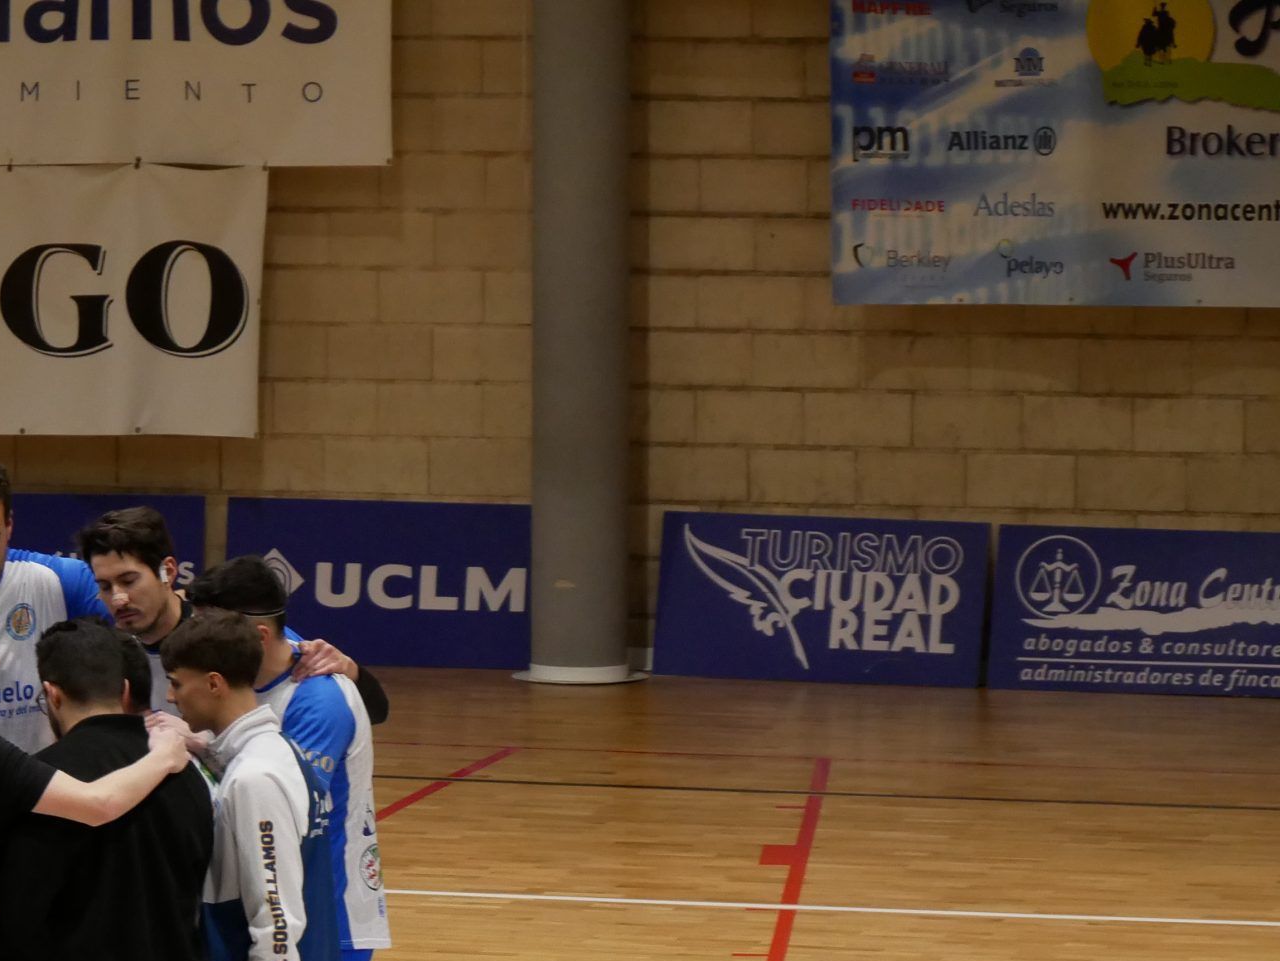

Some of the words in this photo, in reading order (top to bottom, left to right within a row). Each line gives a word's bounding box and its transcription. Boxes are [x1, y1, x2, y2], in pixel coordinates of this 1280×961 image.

[947, 131, 1029, 151] Allianz
[973, 193, 1055, 217] Adeslas
[1007, 256, 1064, 278] pelayo
[1144, 252, 1236, 271] PlusUltra
[741, 528, 964, 577] TURISMO
[315, 562, 527, 613] UCLM
[780, 567, 962, 616] CIUDAD
[1106, 564, 1188, 610] Zona
[828, 608, 955, 655] REAL
[1023, 634, 1133, 657] abogados
[1138, 637, 1154, 654] &
[1020, 663, 1194, 686] administradores
[1198, 667, 1224, 687] de
